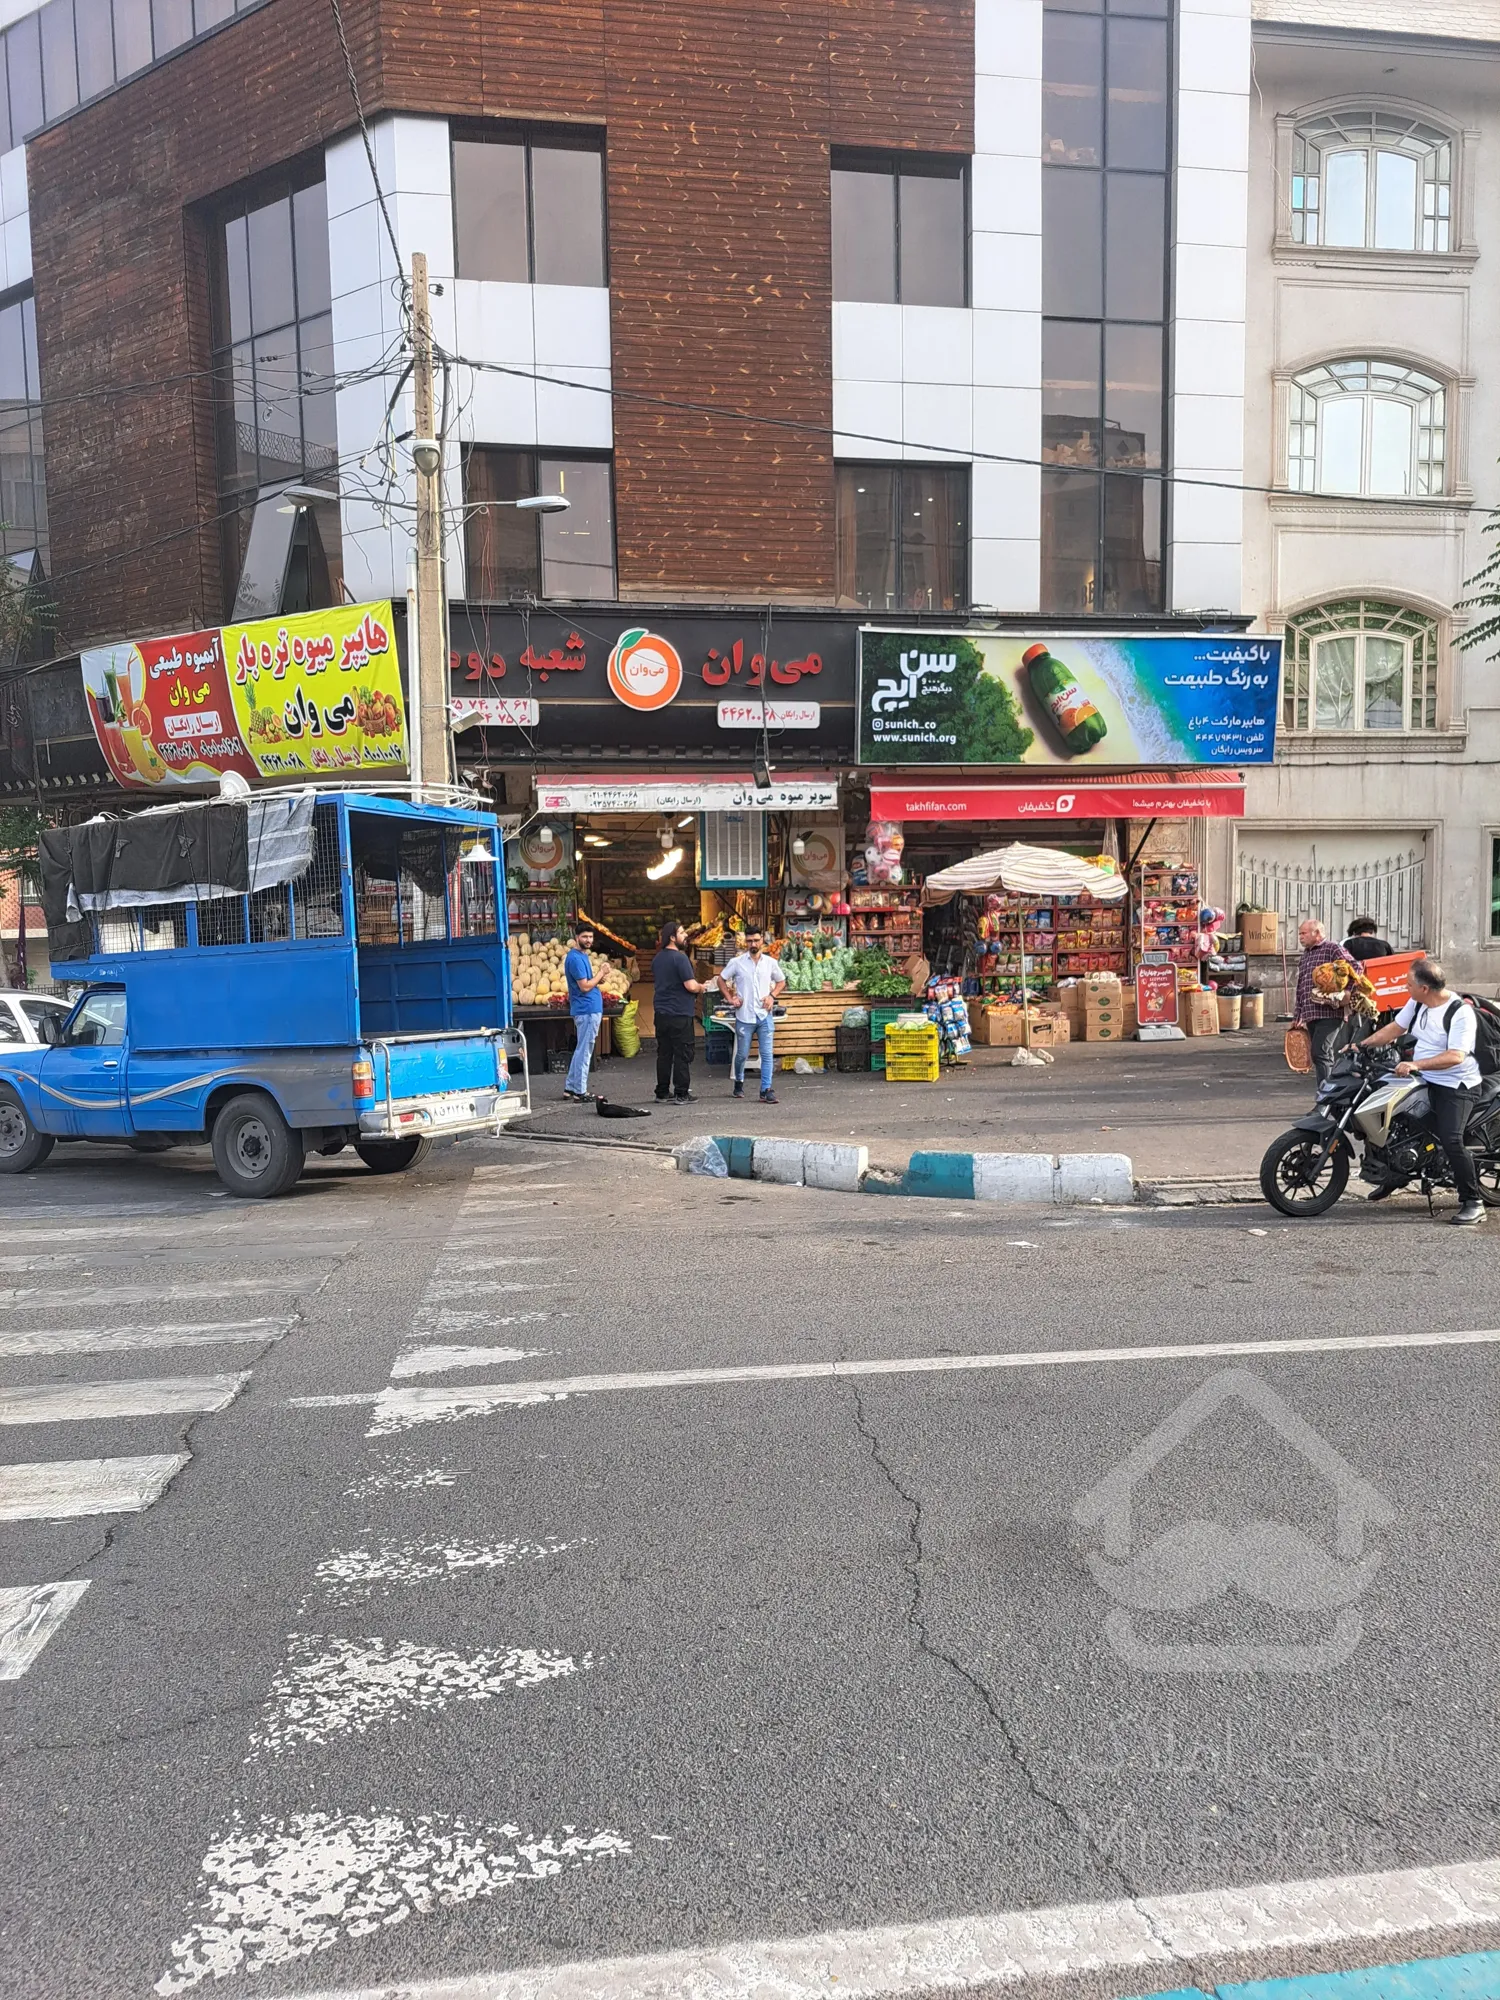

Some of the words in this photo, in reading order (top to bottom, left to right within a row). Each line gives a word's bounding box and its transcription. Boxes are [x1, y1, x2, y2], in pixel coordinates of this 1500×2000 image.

[341, 612, 388, 670] هایپر
[149, 645, 183, 679] طبیعی
[185, 636, 219, 673] آبمیوه
[236, 632, 258, 684] بار
[260, 627, 290, 680] تره
[292, 634, 334, 675] میوه
[519, 631, 586, 682] شعبه
[900, 649, 957, 678] سن
[1164, 669, 1223, 689] طبیعت
[1225, 667, 1252, 690] رنگ
[1253, 673, 1269, 689] به
[169, 677, 192, 707] وان
[192, 681, 211, 704] می
[871, 673, 917, 713] ایچ
[284, 683, 322, 739] وان
[324, 694, 356, 736] می
[780, 710, 799, 720] رایگان
[799, 711, 815, 720] ارسال
[166, 717, 195, 736] رایگان
[195, 715, 220, 733] ارسال
[885, 719, 936, 729] sunich_co
[873, 732, 957, 745] www.sunich.org
[1246, 733, 1264, 744] تلفن
[335, 745, 361, 767] ارسال
[1211, 744, 1233, 756] رایگان
[1234, 746, 1264, 755] سرویس
[732, 790, 753, 805] وان
[756, 793, 774, 805] می
[780, 792, 804, 805] میوه
[807, 791, 833, 805] سوپر
[905, 801, 967, 812] takhfifan.com
[1177, 799, 1206, 809] تخفیفان
[1017, 801, 1055, 813] تخفیفان
[1248, 929, 1275, 940] Winston
